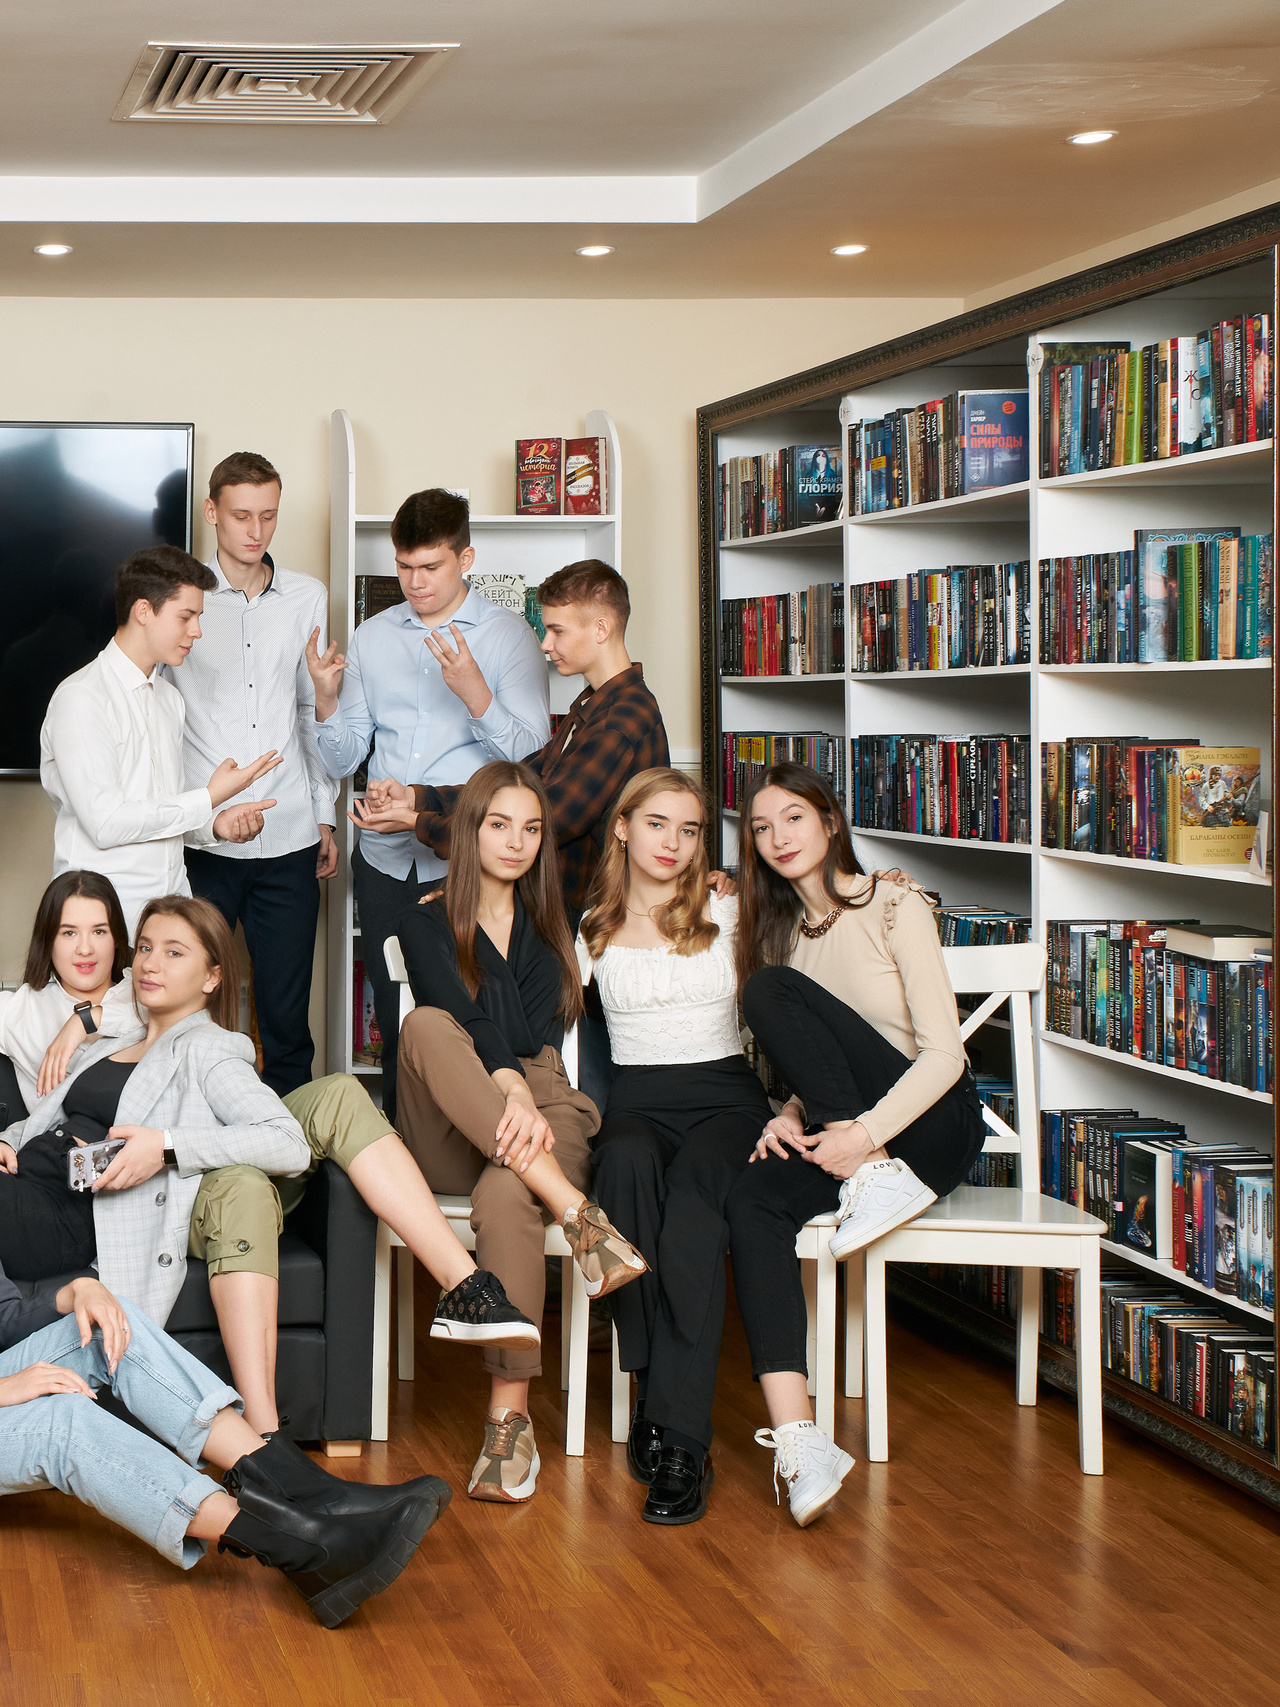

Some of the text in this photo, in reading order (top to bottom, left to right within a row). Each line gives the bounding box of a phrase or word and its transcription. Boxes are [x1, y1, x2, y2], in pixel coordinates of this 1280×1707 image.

[970, 423, 1001, 436] СИЛЫ
[970, 436, 1023, 450] ПРИРОДЫ
[526, 443, 553, 460] 12
[798, 484, 843, 494] ГЛОРИЯ
[484, 589, 512, 599] КЕЙТ
[492, 599, 520, 607] РТОН
